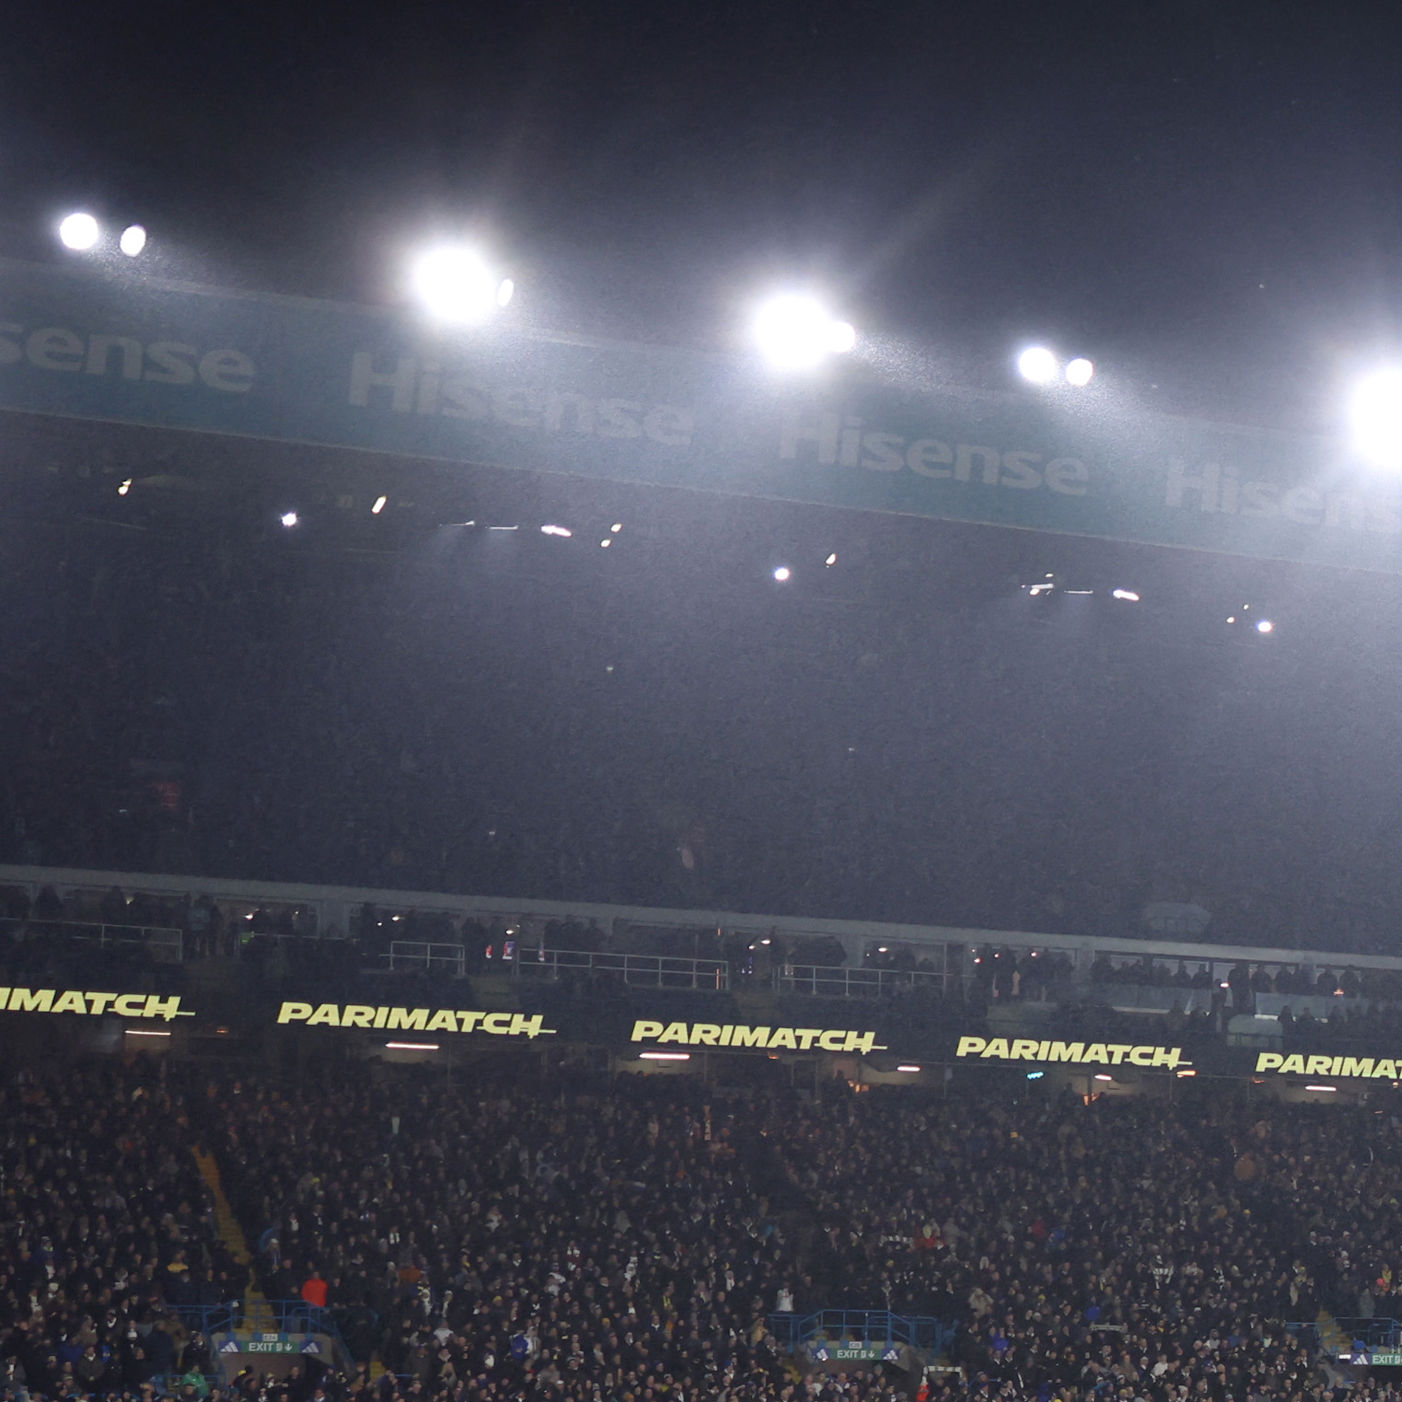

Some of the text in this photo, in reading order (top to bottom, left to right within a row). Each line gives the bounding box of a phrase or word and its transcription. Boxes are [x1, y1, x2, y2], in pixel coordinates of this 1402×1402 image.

[350, 351, 695, 446] Hisense
[779, 410, 1091, 496] Hisense
[277, 1001, 557, 1039] PARIMATCH
[631, 1020, 887, 1055] PARIMATCH
[956, 1036, 1192, 1071] PARIMATCH
[248, 1343, 273, 1351] EXIT
[837, 1350, 858, 1359] EXIT
[1372, 1354, 1393, 1364] EXIT
